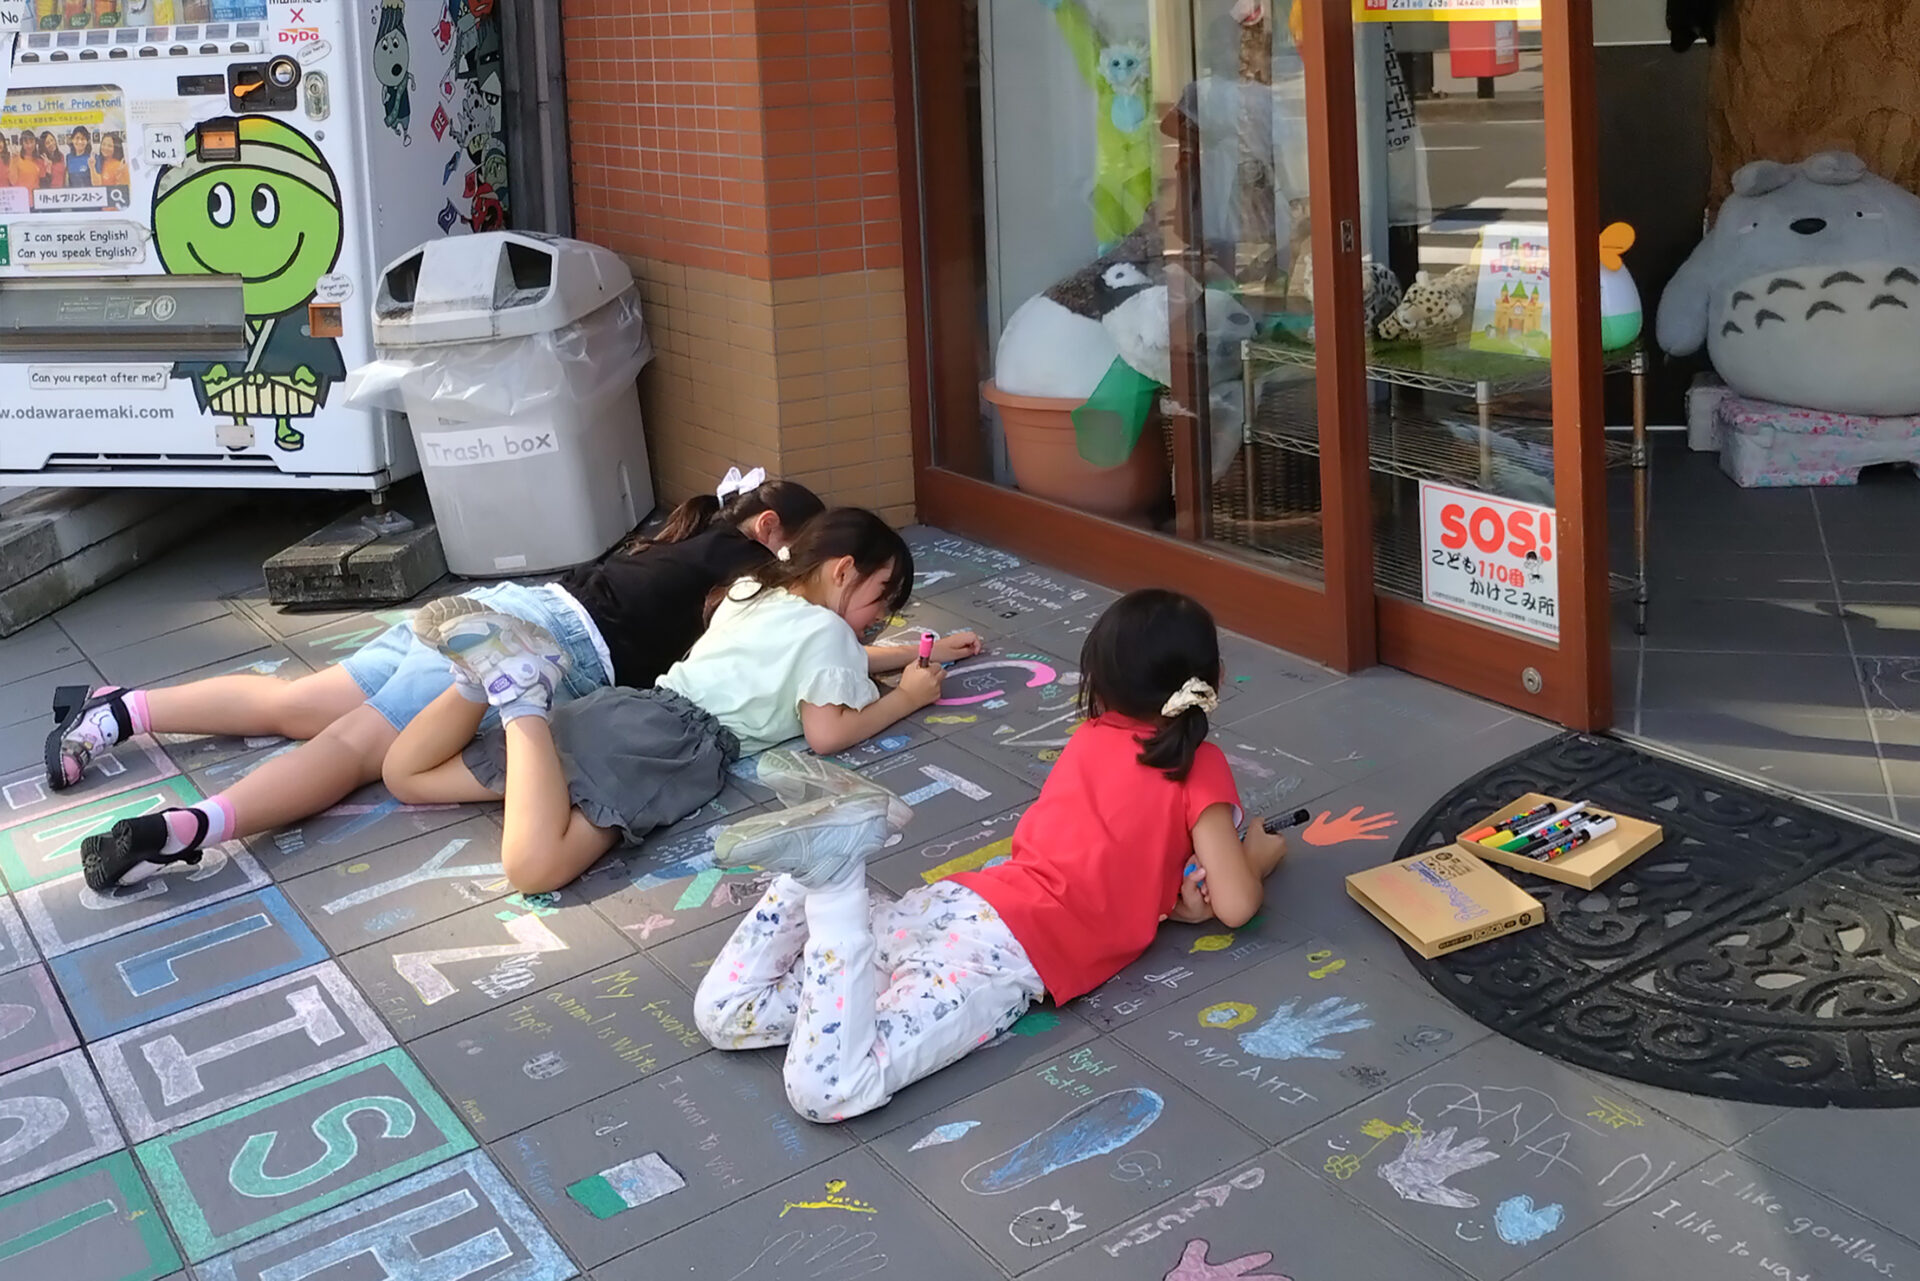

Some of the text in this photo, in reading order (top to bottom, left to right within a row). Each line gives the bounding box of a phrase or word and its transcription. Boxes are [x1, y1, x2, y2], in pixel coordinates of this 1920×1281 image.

[279, 30, 319, 44] DyDo
[22, 103, 33, 111] to
[38, 101, 65, 111] Little
[154, 133, 172, 143] I'm
[24, 230, 129, 244] I can speak English!
[18, 246, 138, 260] Can you speak English?
[32, 372, 162, 384] Can you repeat after me?
[427, 434, 552, 462] Trash box
[1440, 503, 1552, 562] SOS!
[1470, 578, 1555, 617] かけこみ所
[592, 969, 639, 1000] My
[1069, 1048, 1118, 1076] Right
[1652, 1199, 1682, 1219] I
[1675, 1211, 1722, 1244] like
[1728, 1240, 1749, 1257] to
[1702, 1169, 1893, 1278] I like gorillas.
